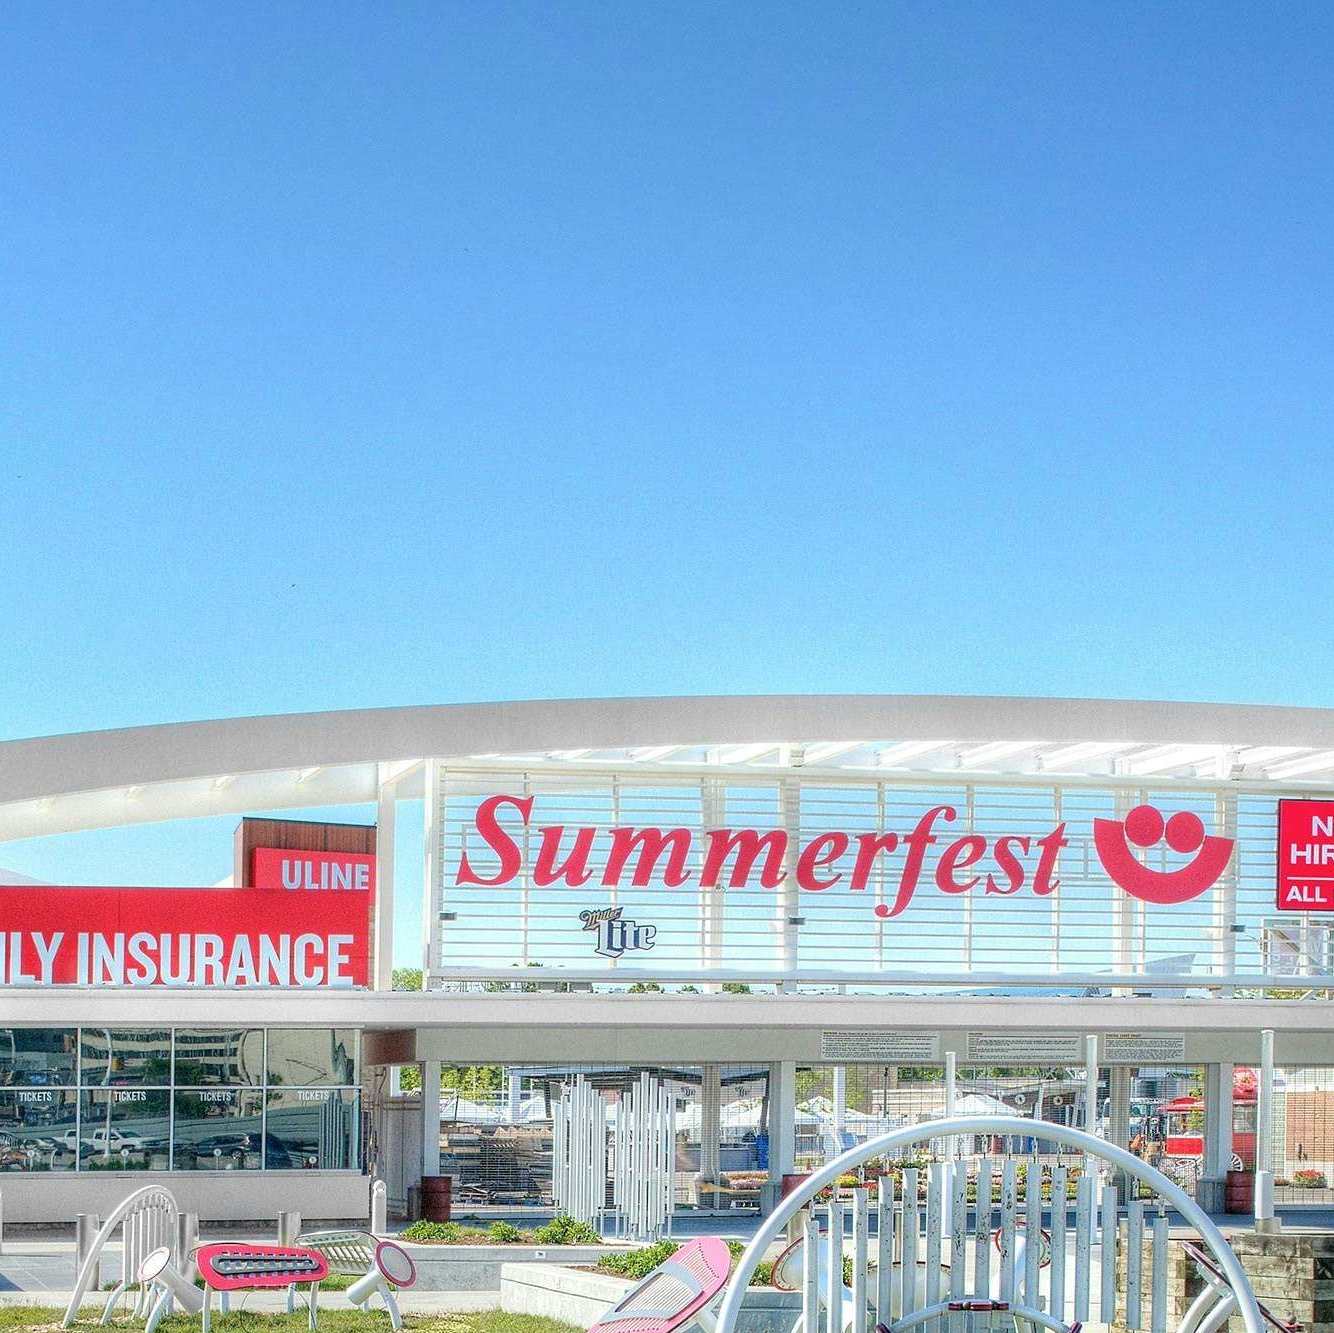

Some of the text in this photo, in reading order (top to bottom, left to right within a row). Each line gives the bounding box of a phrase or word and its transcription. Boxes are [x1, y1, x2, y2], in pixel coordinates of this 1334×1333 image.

[454, 795, 1067, 918] Summerfest
[281, 859, 370, 890] ULINE
[1286, 885, 1327, 902] ALL
[579, 907, 623, 931] Miller
[594, 919, 657, 958] Lite
[77, 932, 355, 987] INSURANCE
[19, 1091, 52, 1102] TICKETS
[114, 1091, 146, 1102] TICKETS
[199, 1091, 232, 1102] TICKETS
[298, 1091, 330, 1101] TICKETS
